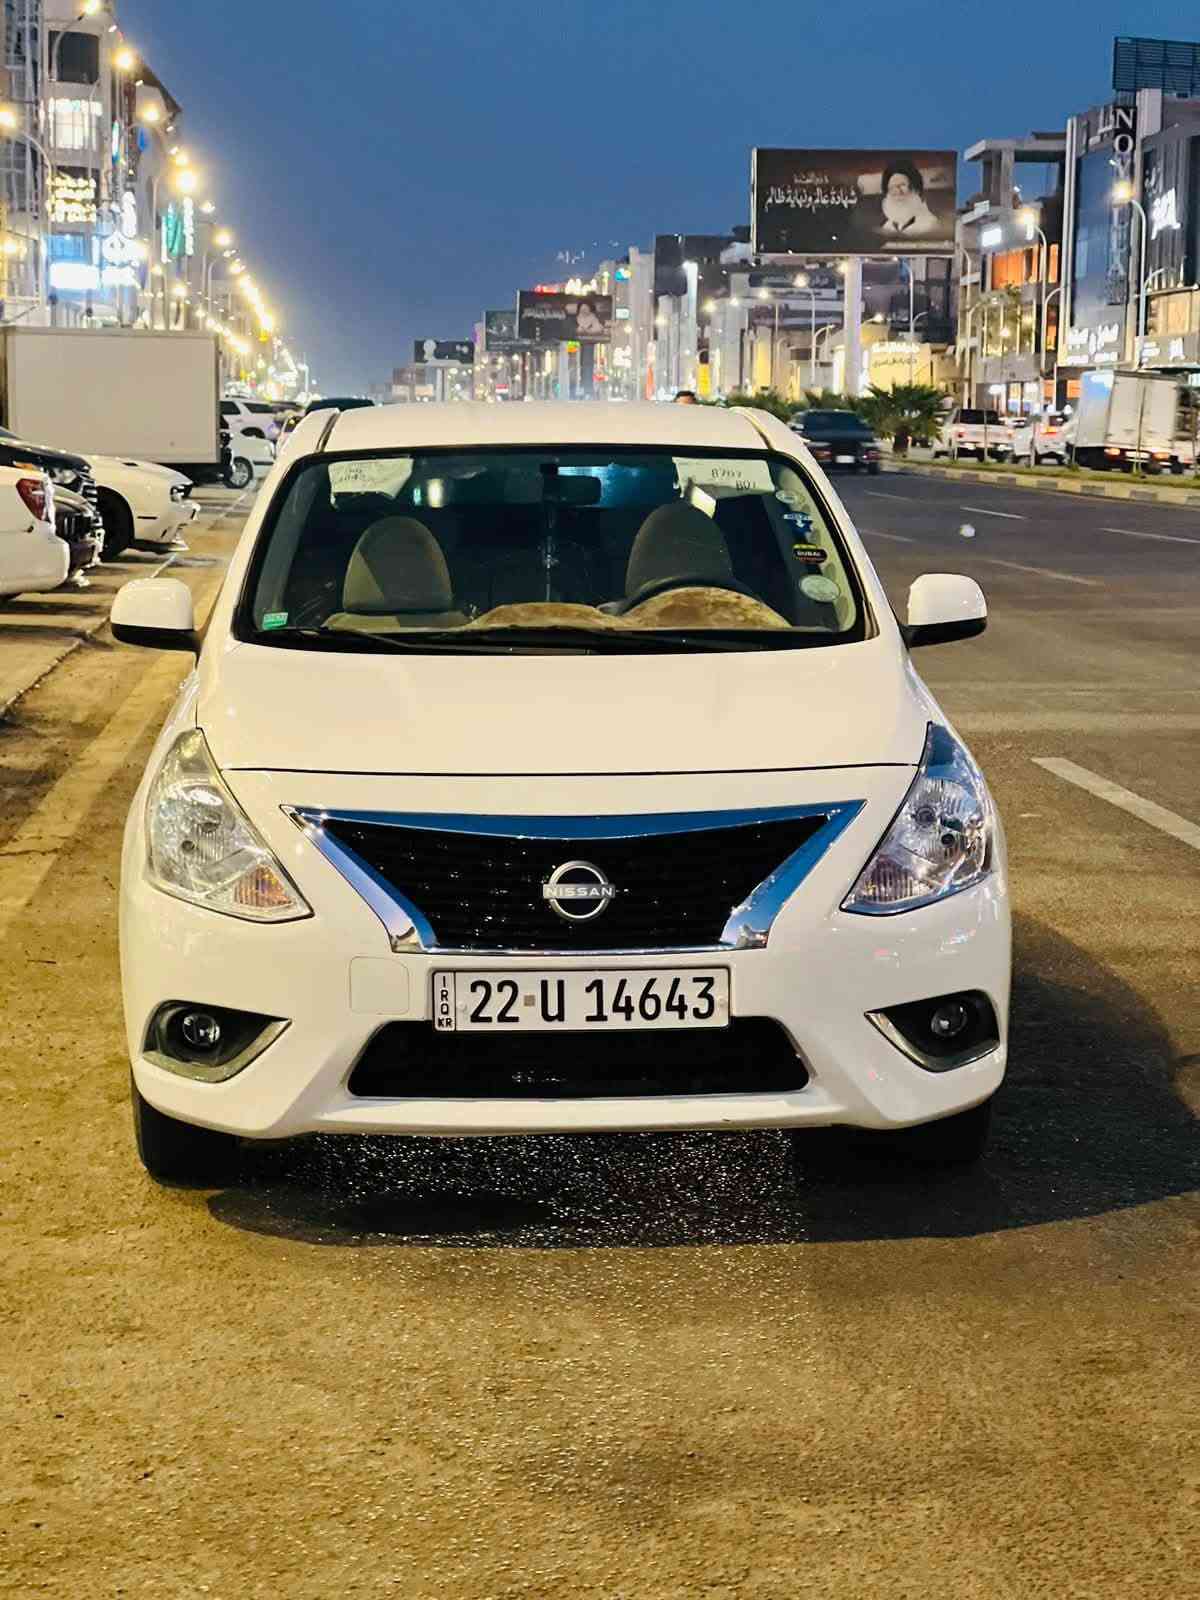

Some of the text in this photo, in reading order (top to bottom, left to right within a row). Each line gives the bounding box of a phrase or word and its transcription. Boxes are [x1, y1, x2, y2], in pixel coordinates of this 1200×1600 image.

[764, 186, 785, 213] ظالم
[811, 187, 829, 214] عالم
[830, 185, 858, 208] شهادة
[546, 887, 613, 897] NISSAN
[470, 976, 715, 1023] 22 U 14643
[438, 1017, 453, 1028] KR
